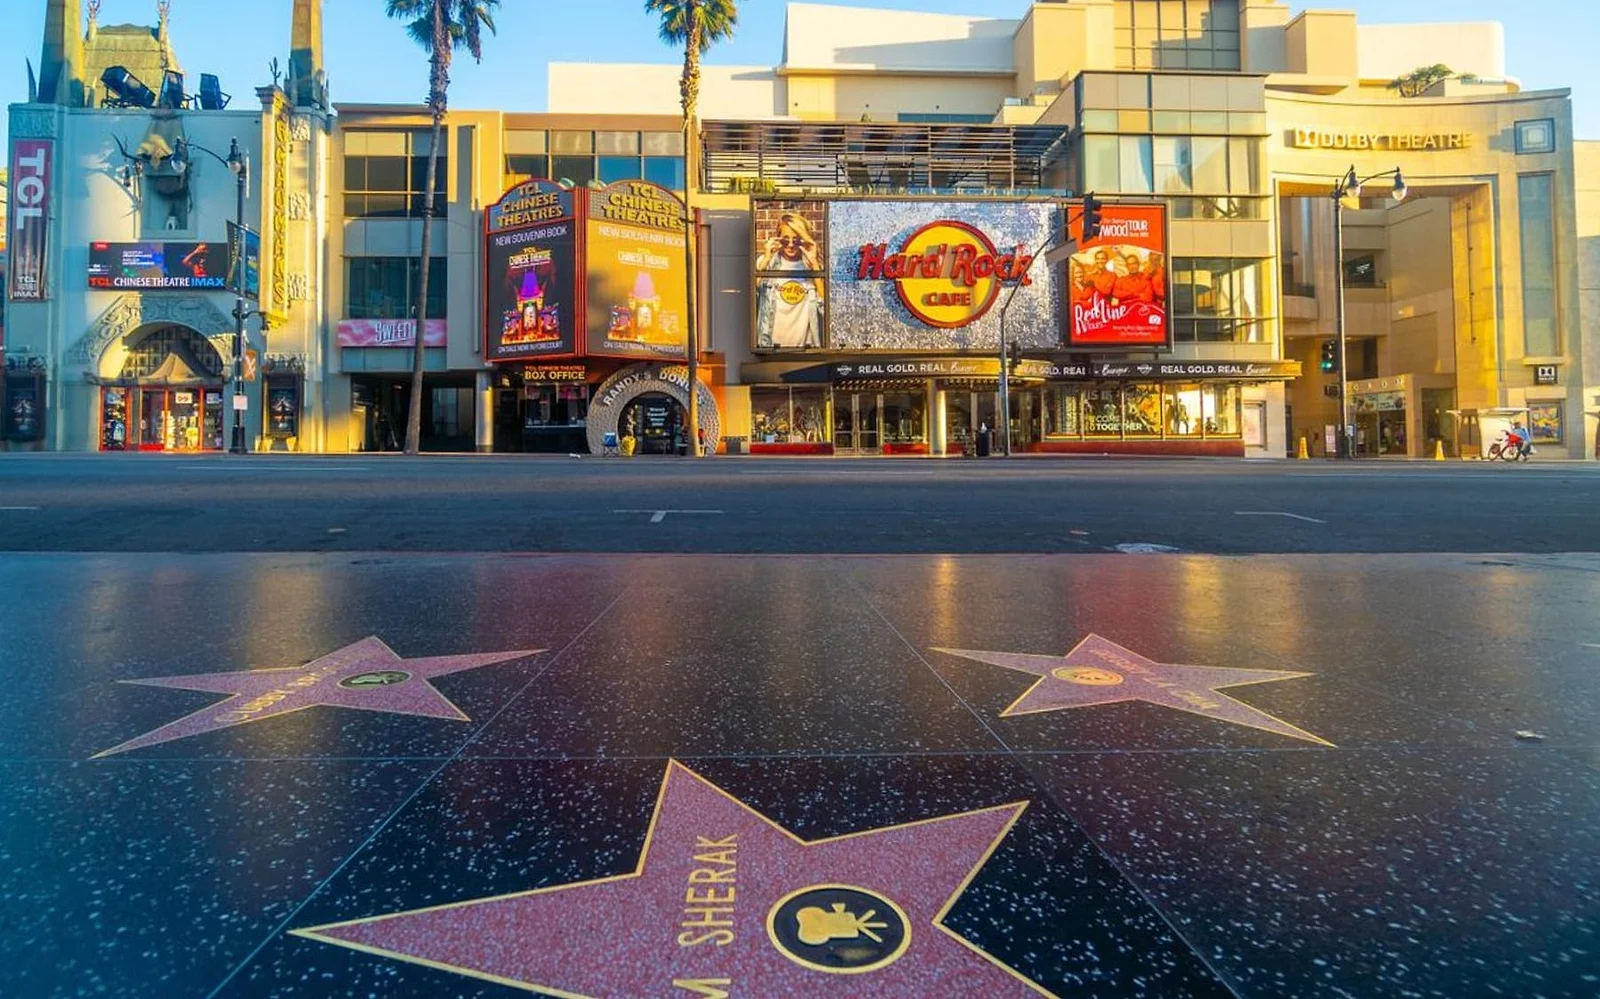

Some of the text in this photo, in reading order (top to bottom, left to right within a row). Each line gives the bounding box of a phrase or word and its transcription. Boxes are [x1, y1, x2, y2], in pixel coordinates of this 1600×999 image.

[1318, 132, 1472, 150] DOLBY THEATRE
[16, 148, 45, 230] TCL
[518, 182, 542, 196] TCL
[629, 182, 661, 199] TCL
[502, 192, 559, 213] CHINESE
[608, 191, 680, 217] CHINESE
[497, 204, 563, 227] THEATRES
[602, 205, 686, 229] THEATRES
[1128, 219, 1148, 232] TOUR
[496, 225, 568, 246] NEW SOUVENIR BOOK
[857, 242, 1032, 286] Hard Rock
[113, 276, 151, 287] CHINESE
[151, 276, 190, 287] THEATRE
[191, 276, 225, 287] IMAX
[924, 291, 972, 308] CAFE
[524, 371, 585, 380] BOX OFFICE
[858, 365, 884, 374] REAL
[887, 364, 917, 373] GOLD.
[920, 363, 946, 373] REAL
[1160, 365, 1184, 374] REAL
[1187, 365, 1216, 374] GOLD.
[1217, 364, 1243, 374] REAL
[602, 370, 652, 406] RANDY'S
[677, 833, 738, 947] SHERAK
